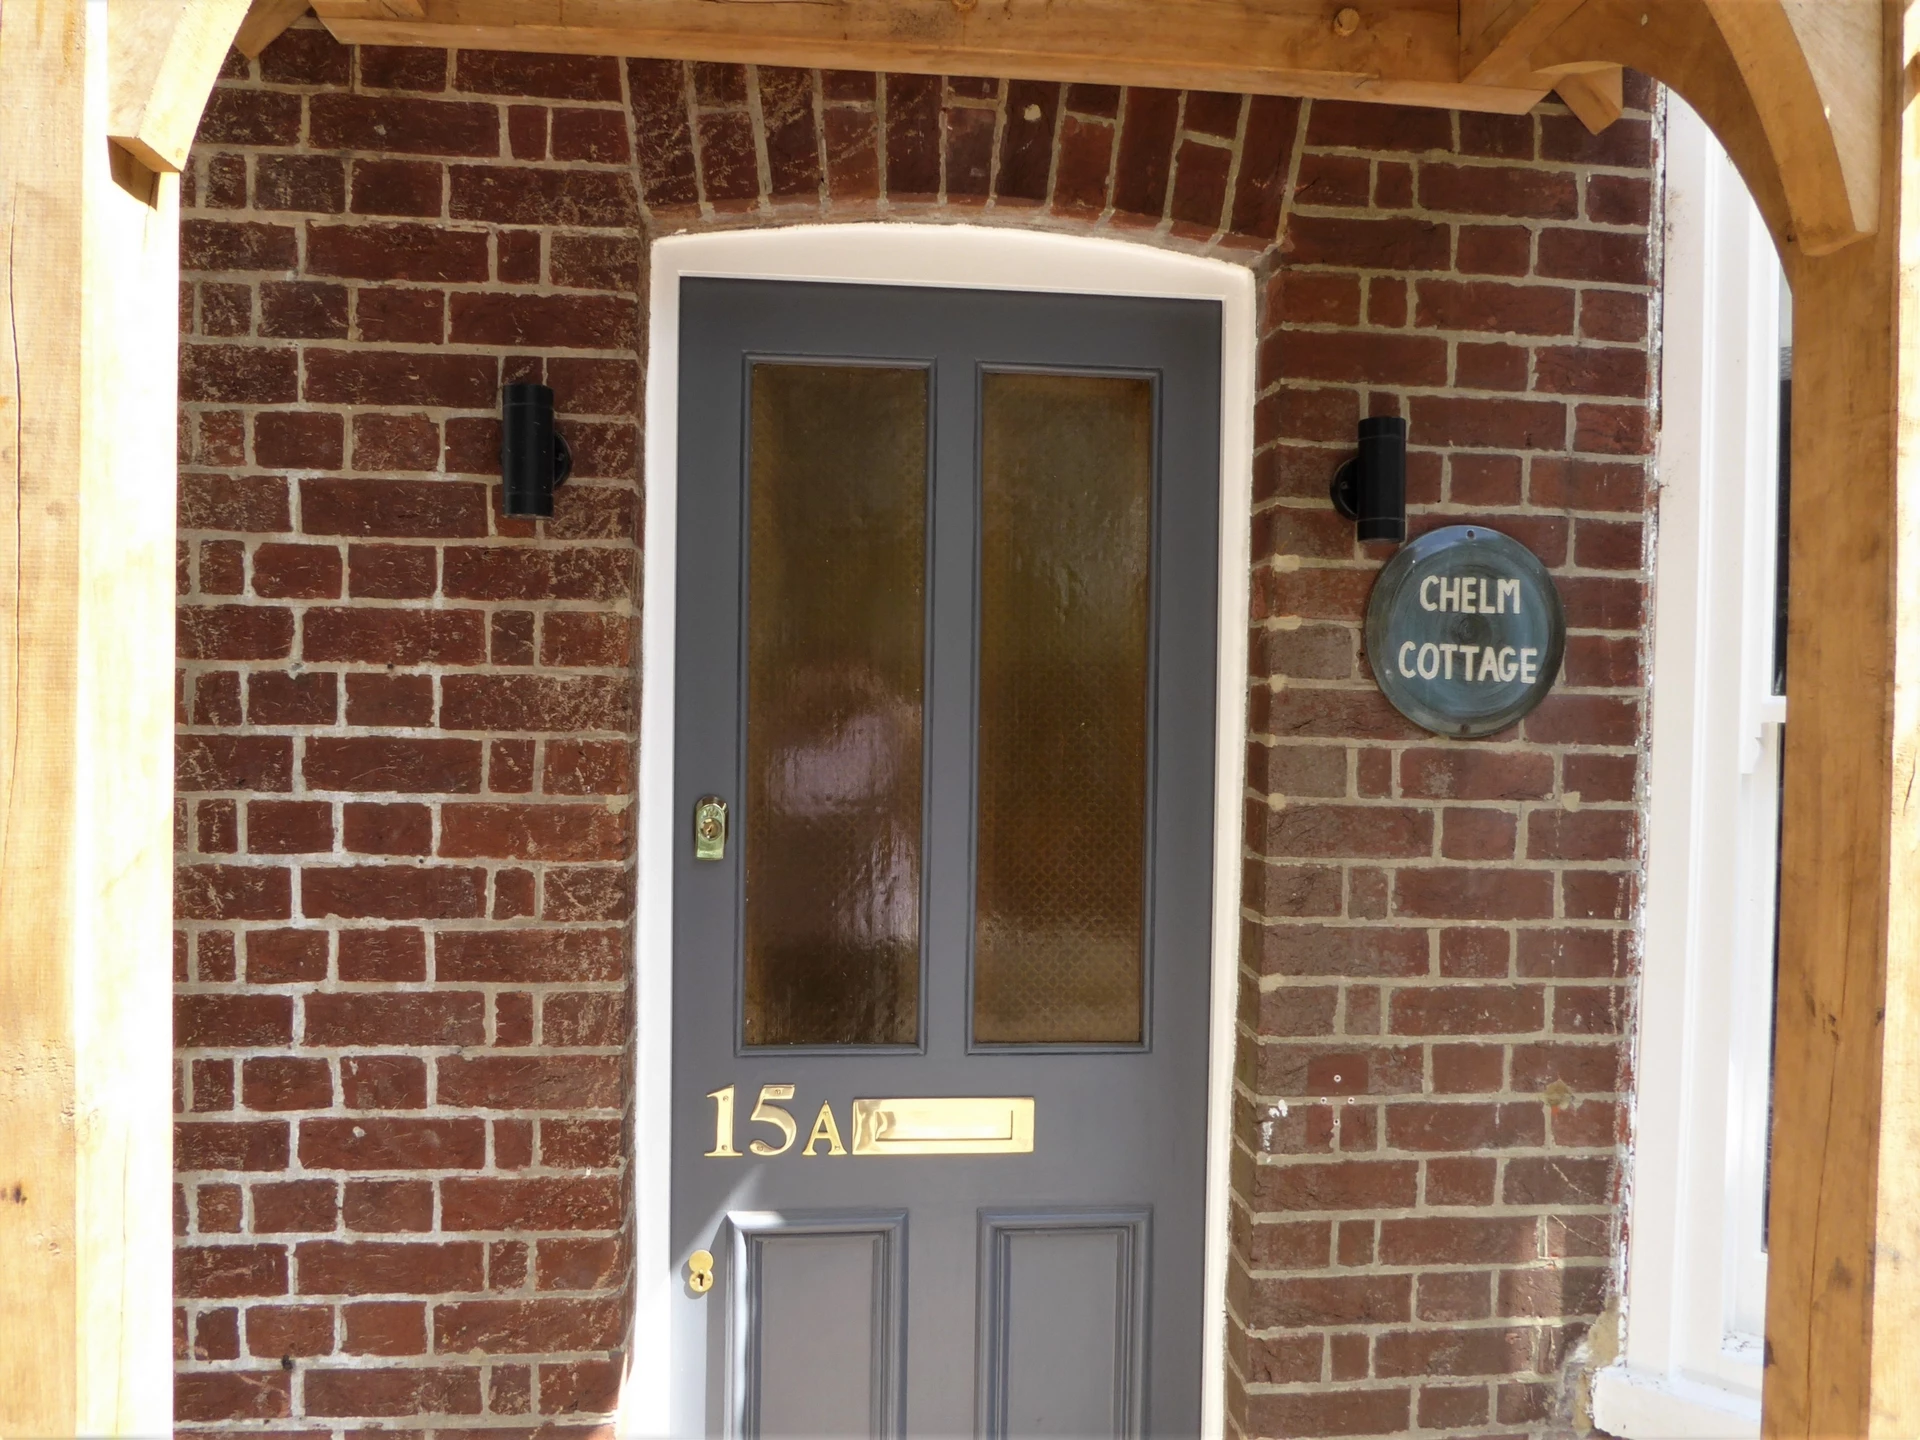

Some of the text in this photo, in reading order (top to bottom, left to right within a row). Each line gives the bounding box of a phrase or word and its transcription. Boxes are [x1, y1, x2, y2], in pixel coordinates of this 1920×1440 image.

[1419, 575, 1521, 614] CHELM
[1398, 641, 1538, 684] COTTAGE
[704, 1083, 848, 1157] 15A
